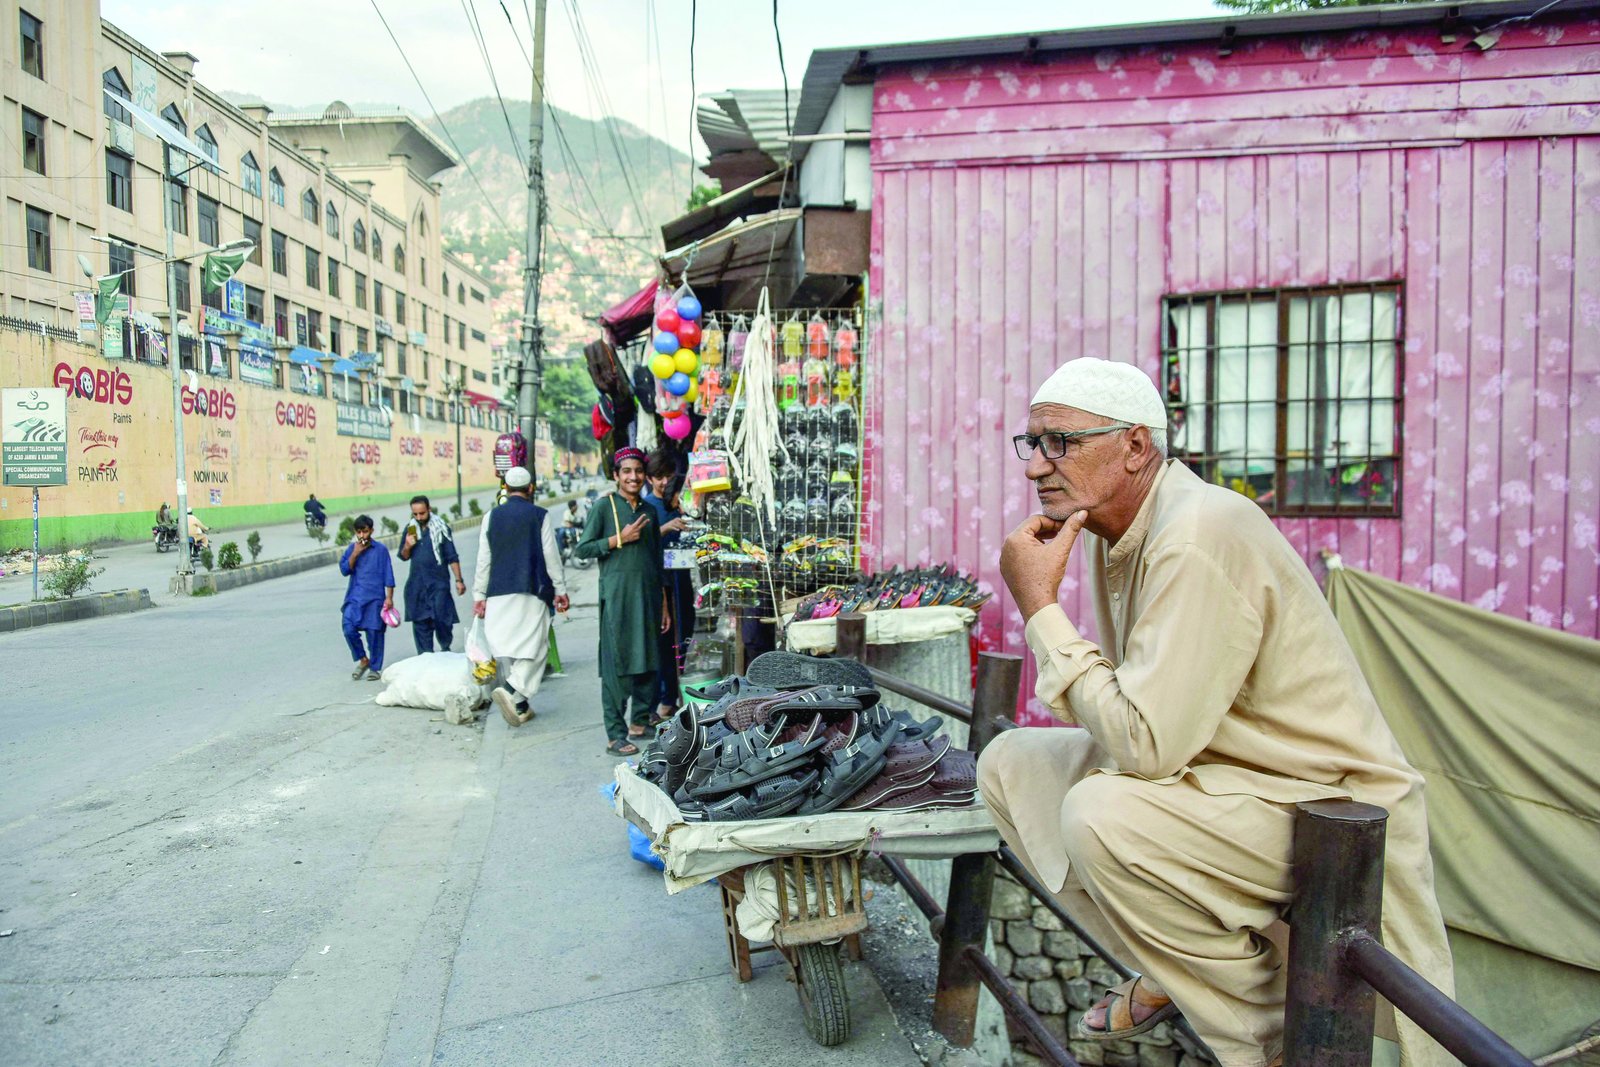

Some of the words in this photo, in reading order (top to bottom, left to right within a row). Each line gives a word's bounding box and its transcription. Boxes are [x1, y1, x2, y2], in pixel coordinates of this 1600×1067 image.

[53, 361, 133, 405] GOBI'S
[181, 385, 236, 420] GOBI'S
[337, 405, 359, 420] TILES
[113, 412, 132, 424] Paints
[275, 400, 317, 430] GOBI'S
[193, 470, 210, 483] NOW
[211, 471, 218, 483] IN
[218, 471, 229, 483] UK
